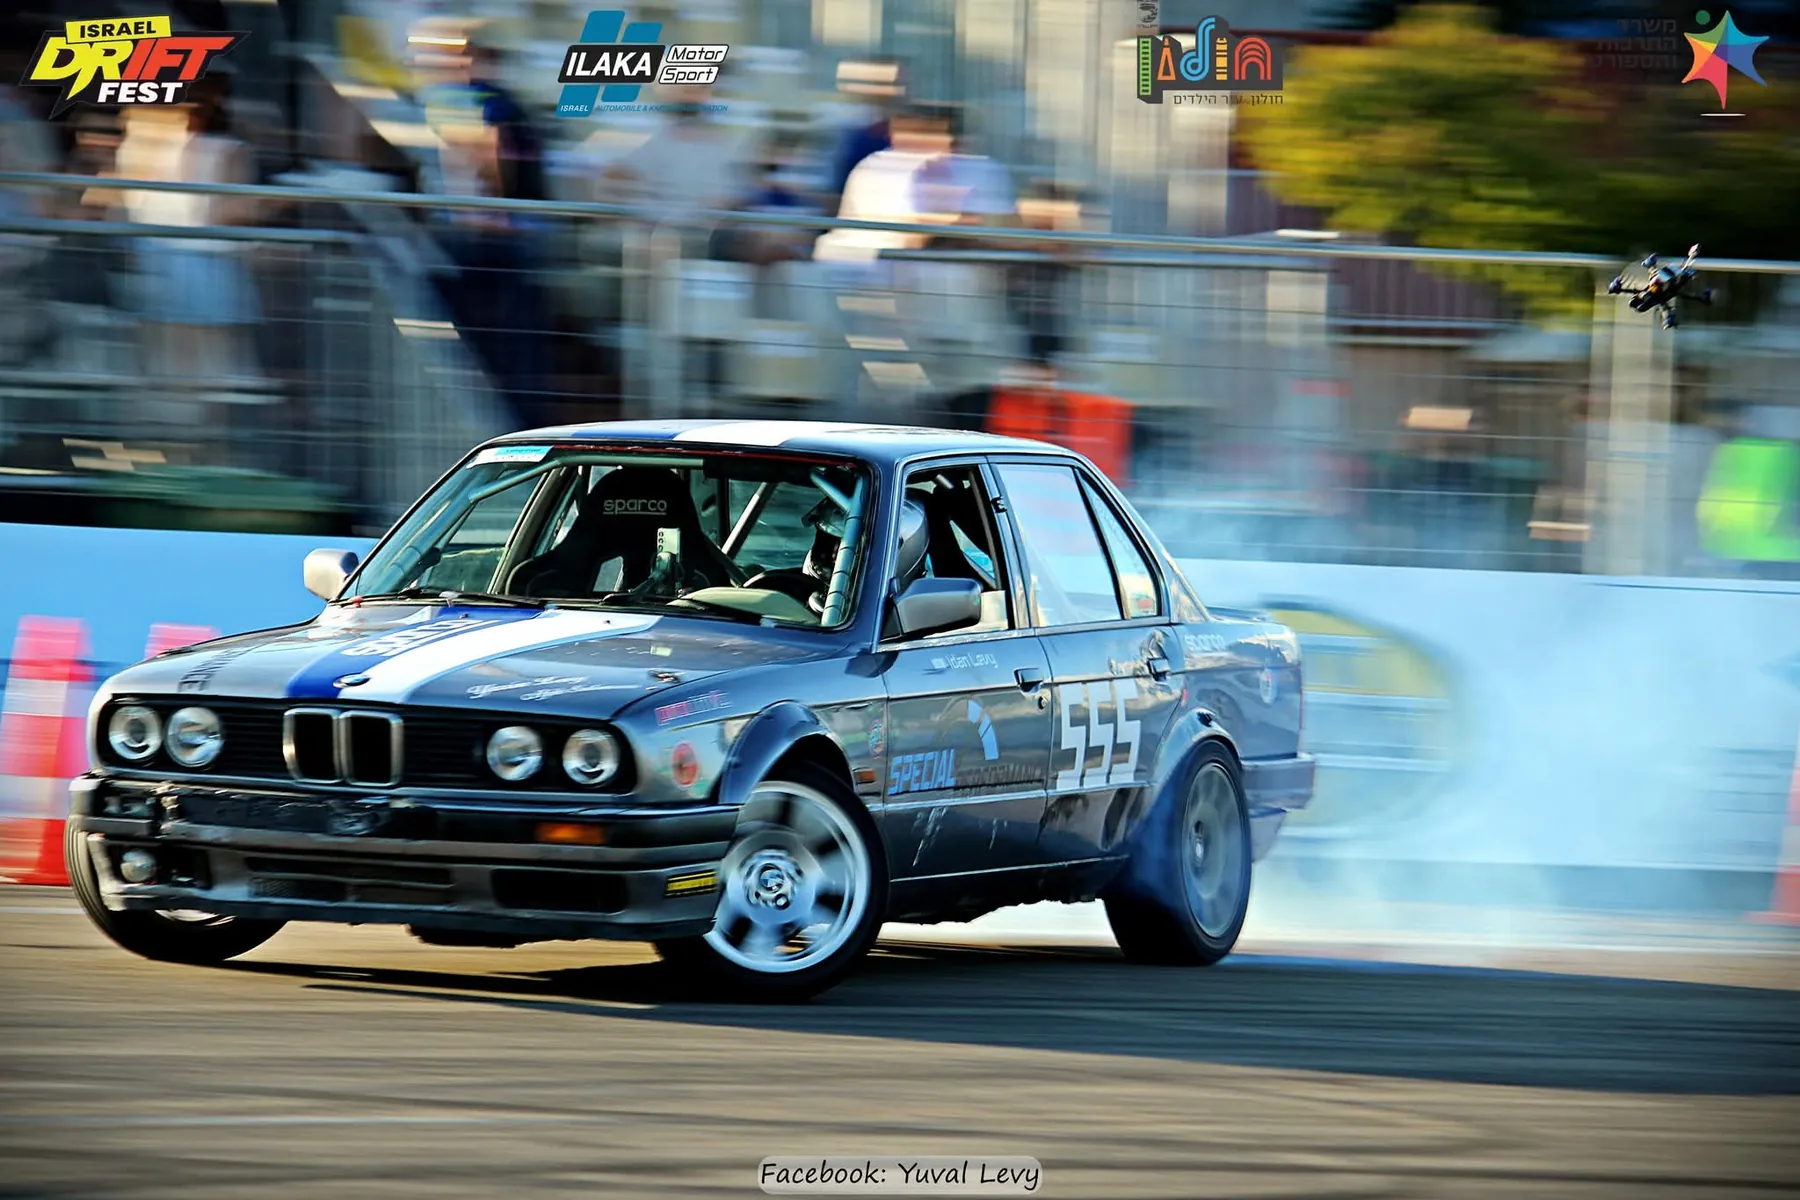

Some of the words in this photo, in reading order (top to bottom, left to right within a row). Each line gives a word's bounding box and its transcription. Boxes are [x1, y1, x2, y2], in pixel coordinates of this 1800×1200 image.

[603, 499, 668, 515] sparco
[1056, 678, 1141, 790] 555
[888, 748, 957, 796] SPECIAL
